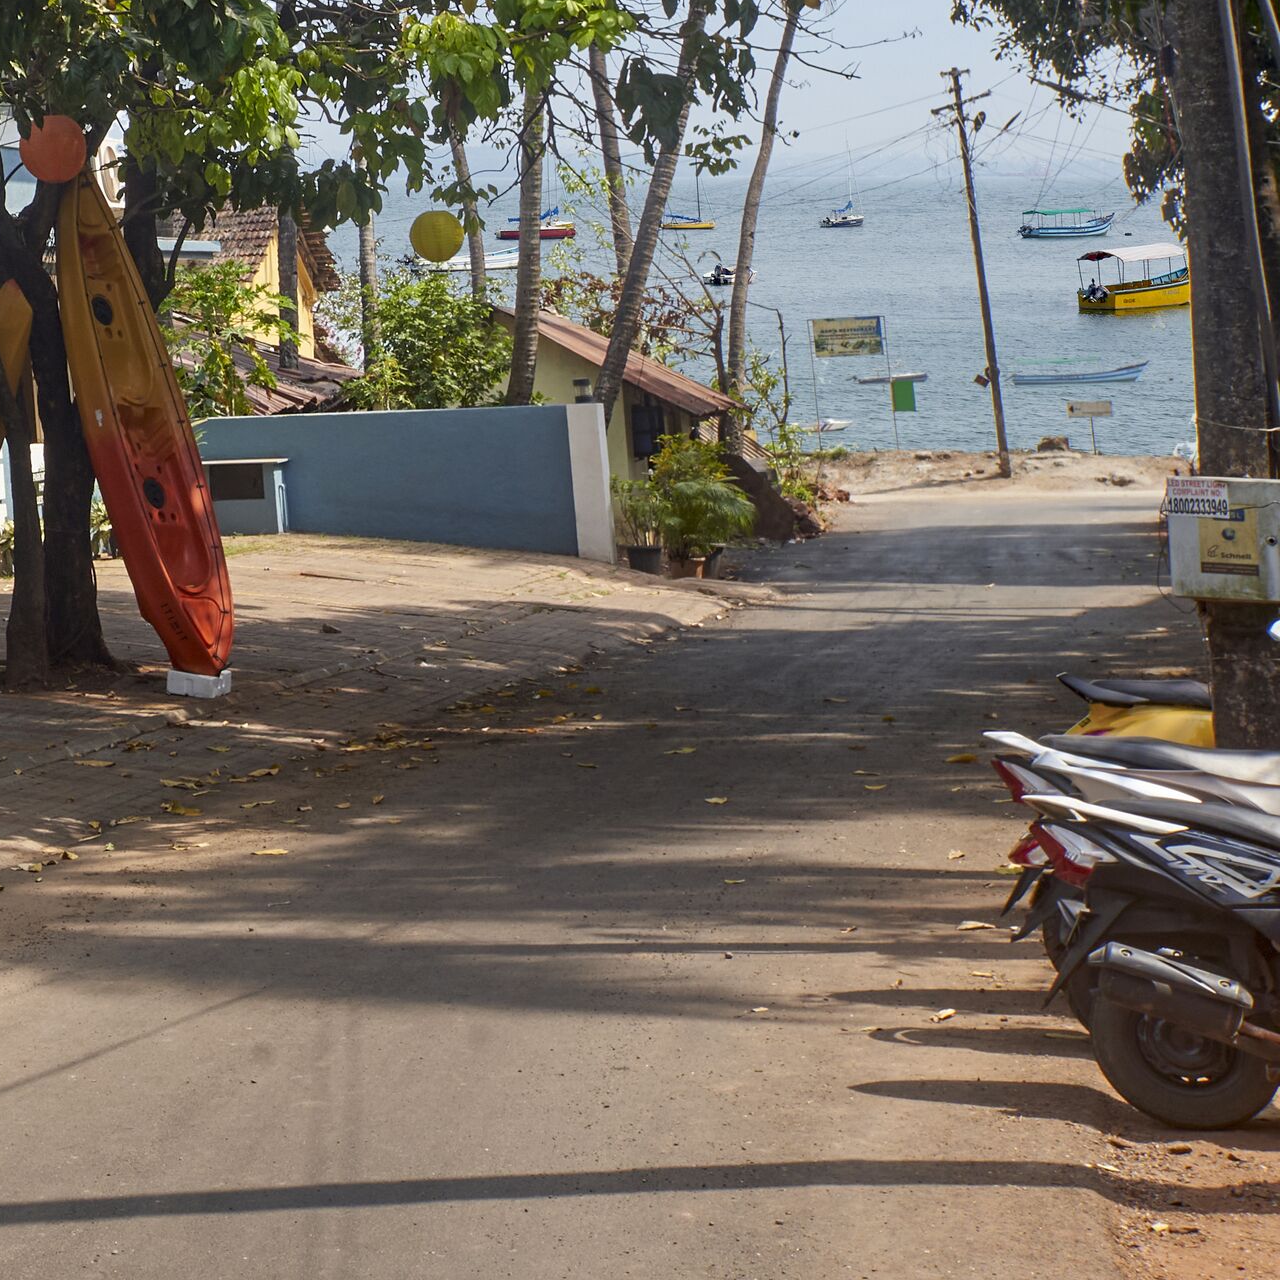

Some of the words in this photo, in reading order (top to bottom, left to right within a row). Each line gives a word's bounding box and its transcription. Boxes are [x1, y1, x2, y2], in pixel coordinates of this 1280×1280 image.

[1182, 480, 1206, 488] STREET
[1168, 497, 1228, 515] 18002333949
[1220, 552, 1251, 560] Schnell
